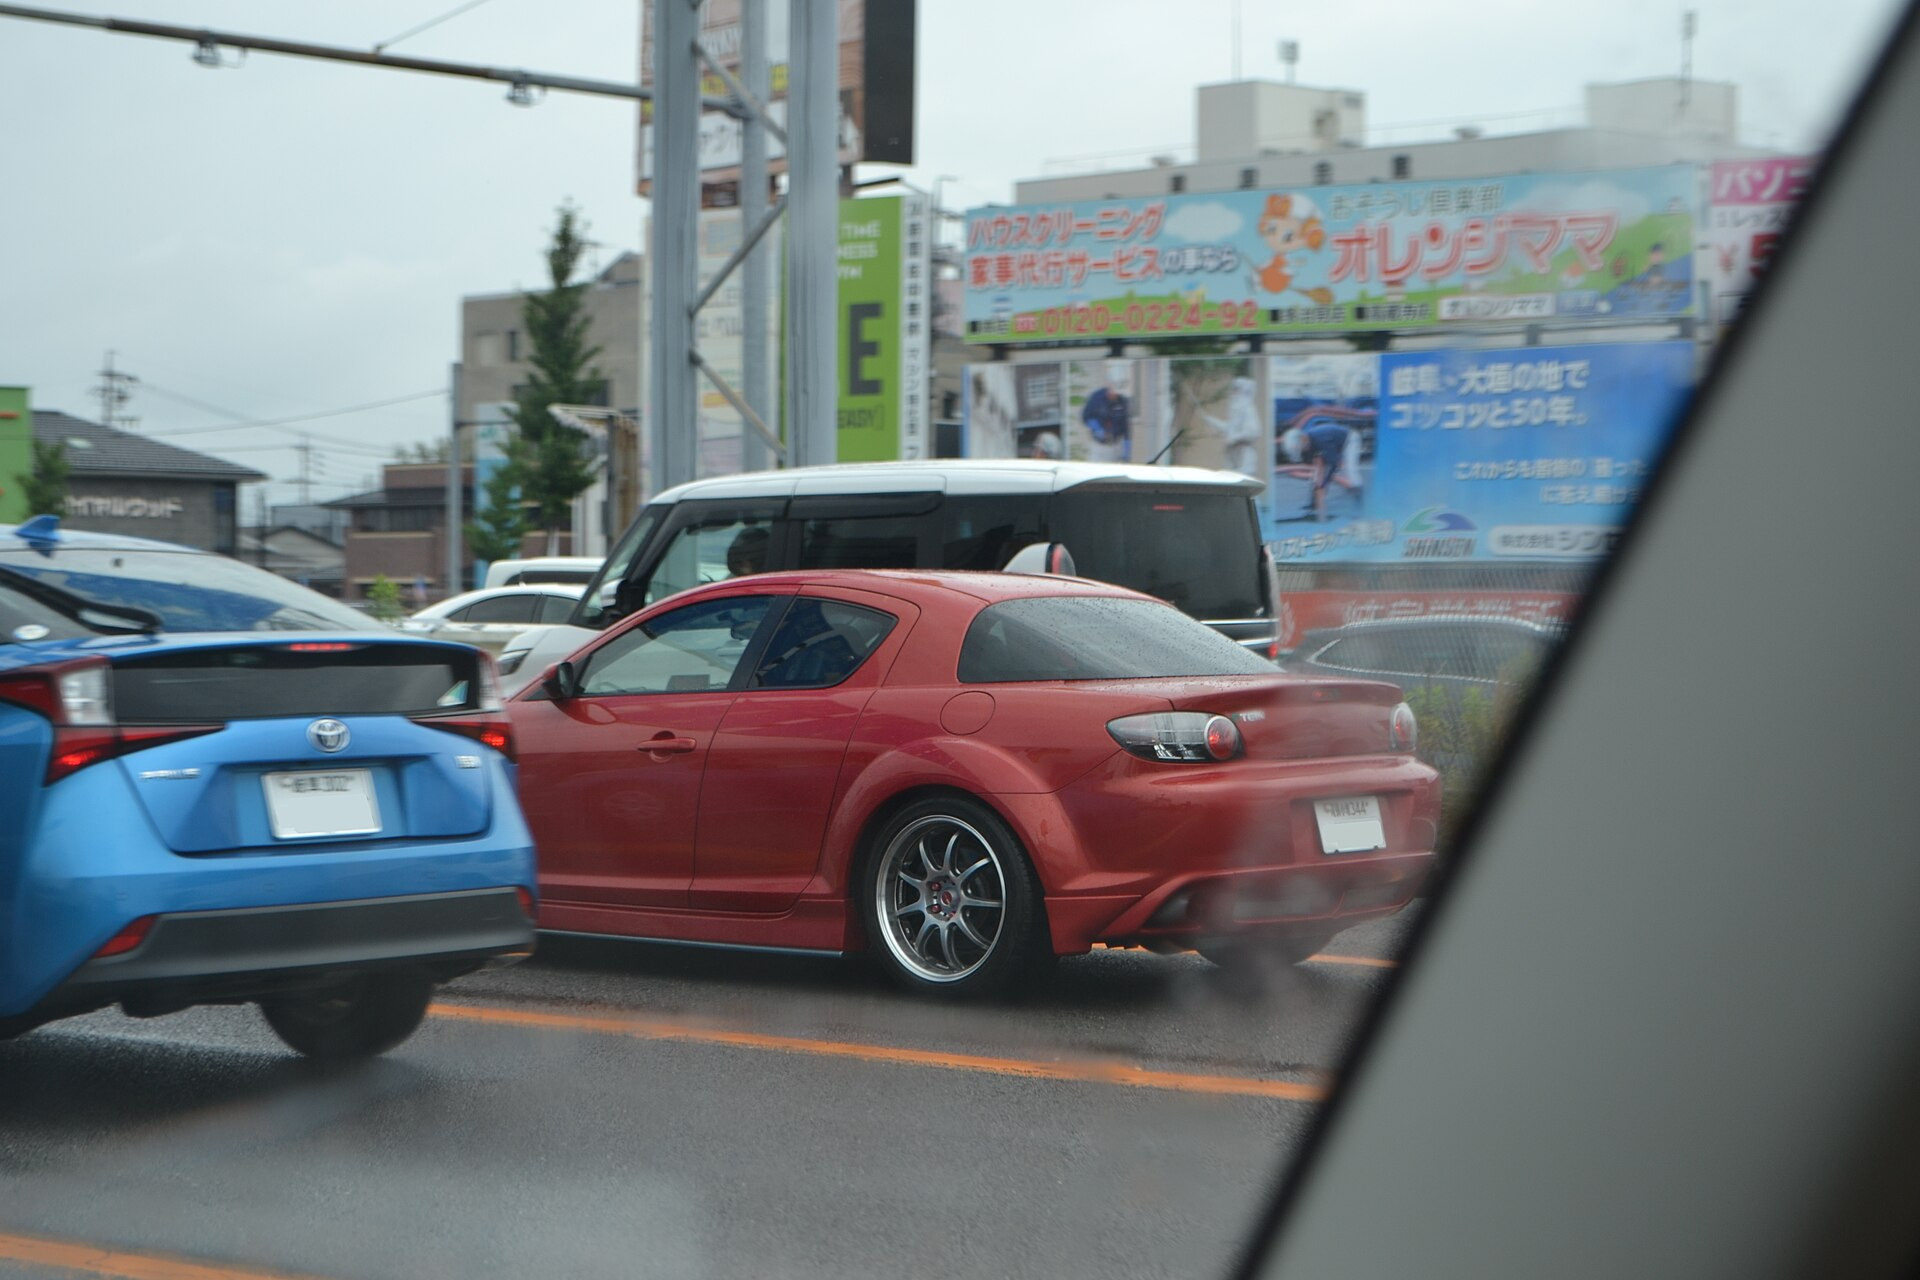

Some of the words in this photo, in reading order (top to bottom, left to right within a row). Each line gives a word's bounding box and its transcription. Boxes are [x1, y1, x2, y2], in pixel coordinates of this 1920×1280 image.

[968, 202, 1166, 247] ハウスクリーニング
[1329, 209, 1620, 283] オレンジママ
[1042, 301, 1258, 335] 0120-0224-92
[1389, 361, 1592, 397] 岐阜・大垣の地で
[1389, 396, 1589, 430] コツコツと50年。
